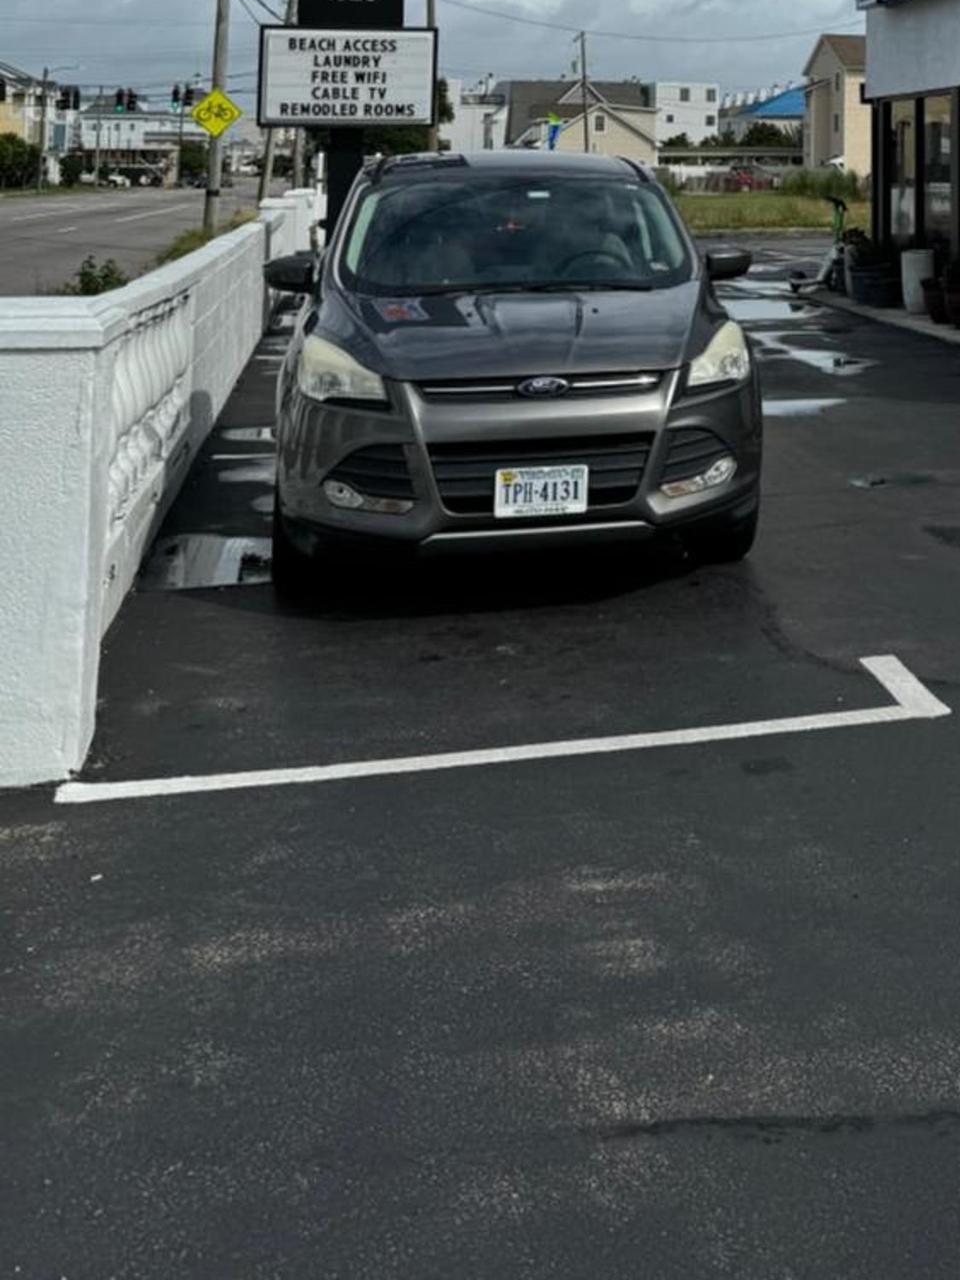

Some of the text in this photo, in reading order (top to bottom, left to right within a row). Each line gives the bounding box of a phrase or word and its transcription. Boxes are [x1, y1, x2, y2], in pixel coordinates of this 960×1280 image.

[288, 37, 397, 52] BEACH ACCESS
[313, 55, 381, 68] LAUNDRY
[311, 71, 387, 84] FREE WIFI
[311, 87, 387, 100] CABLE TV
[363, 104, 415, 117] ROOMS
